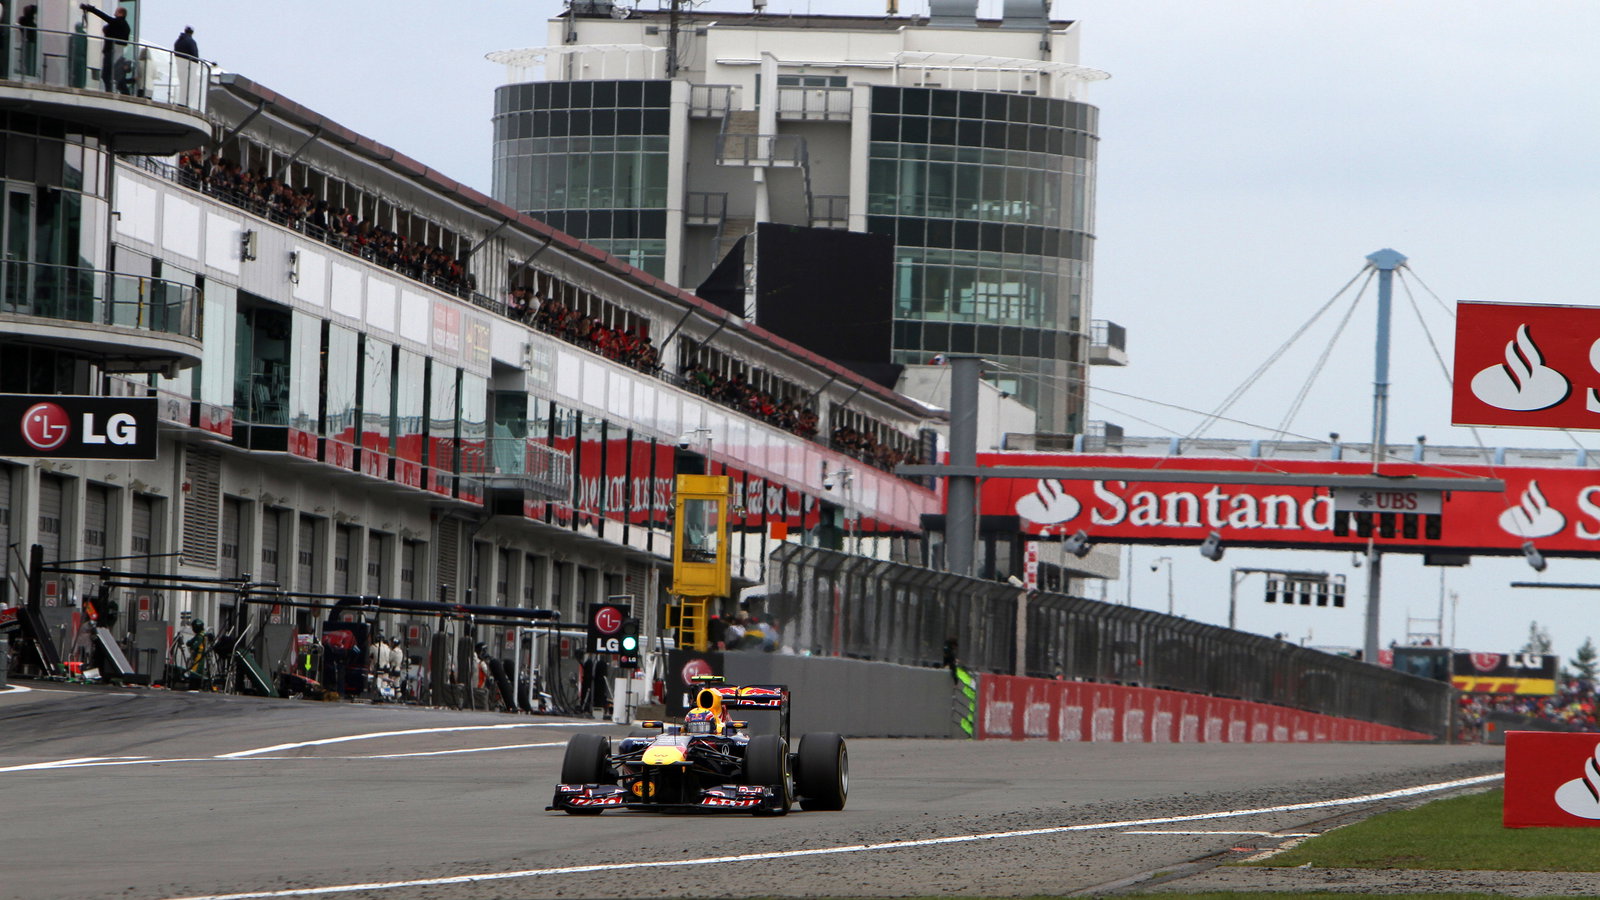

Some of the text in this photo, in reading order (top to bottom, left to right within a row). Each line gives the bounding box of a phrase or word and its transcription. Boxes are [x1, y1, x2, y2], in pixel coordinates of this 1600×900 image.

[82, 412, 137, 445] LG
[1091, 479, 1381, 532] Santand
[1375, 491, 1418, 510] UBS
[596, 638, 619, 652] LG
[1507, 653, 1544, 670] LG
